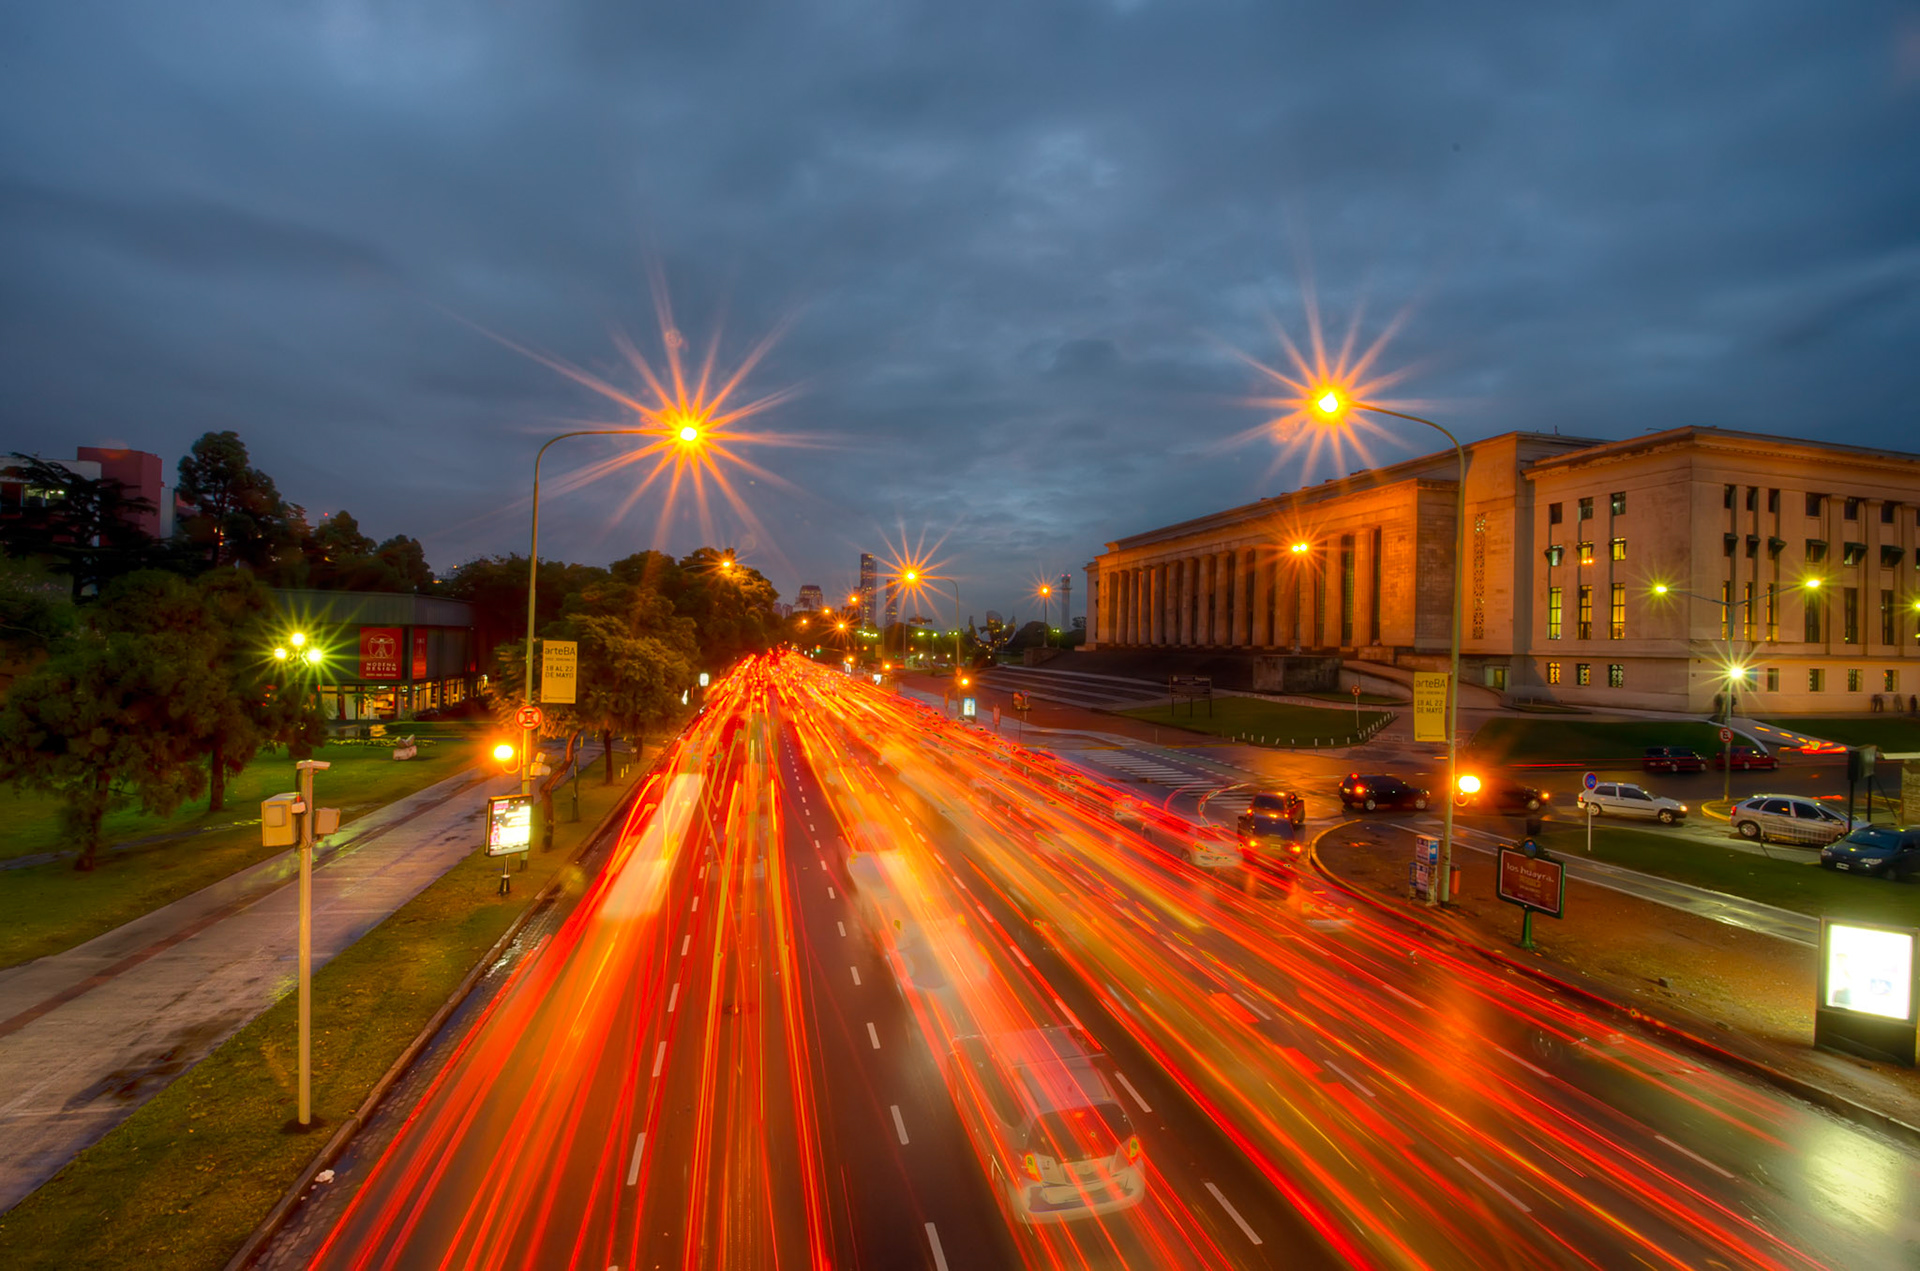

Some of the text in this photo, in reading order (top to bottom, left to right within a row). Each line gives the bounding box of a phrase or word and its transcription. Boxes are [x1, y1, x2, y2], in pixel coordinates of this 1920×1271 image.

[545, 646, 575, 655] arteBA
[1416, 679, 1445, 688] arteBA
[1506, 863, 1519, 872] los
